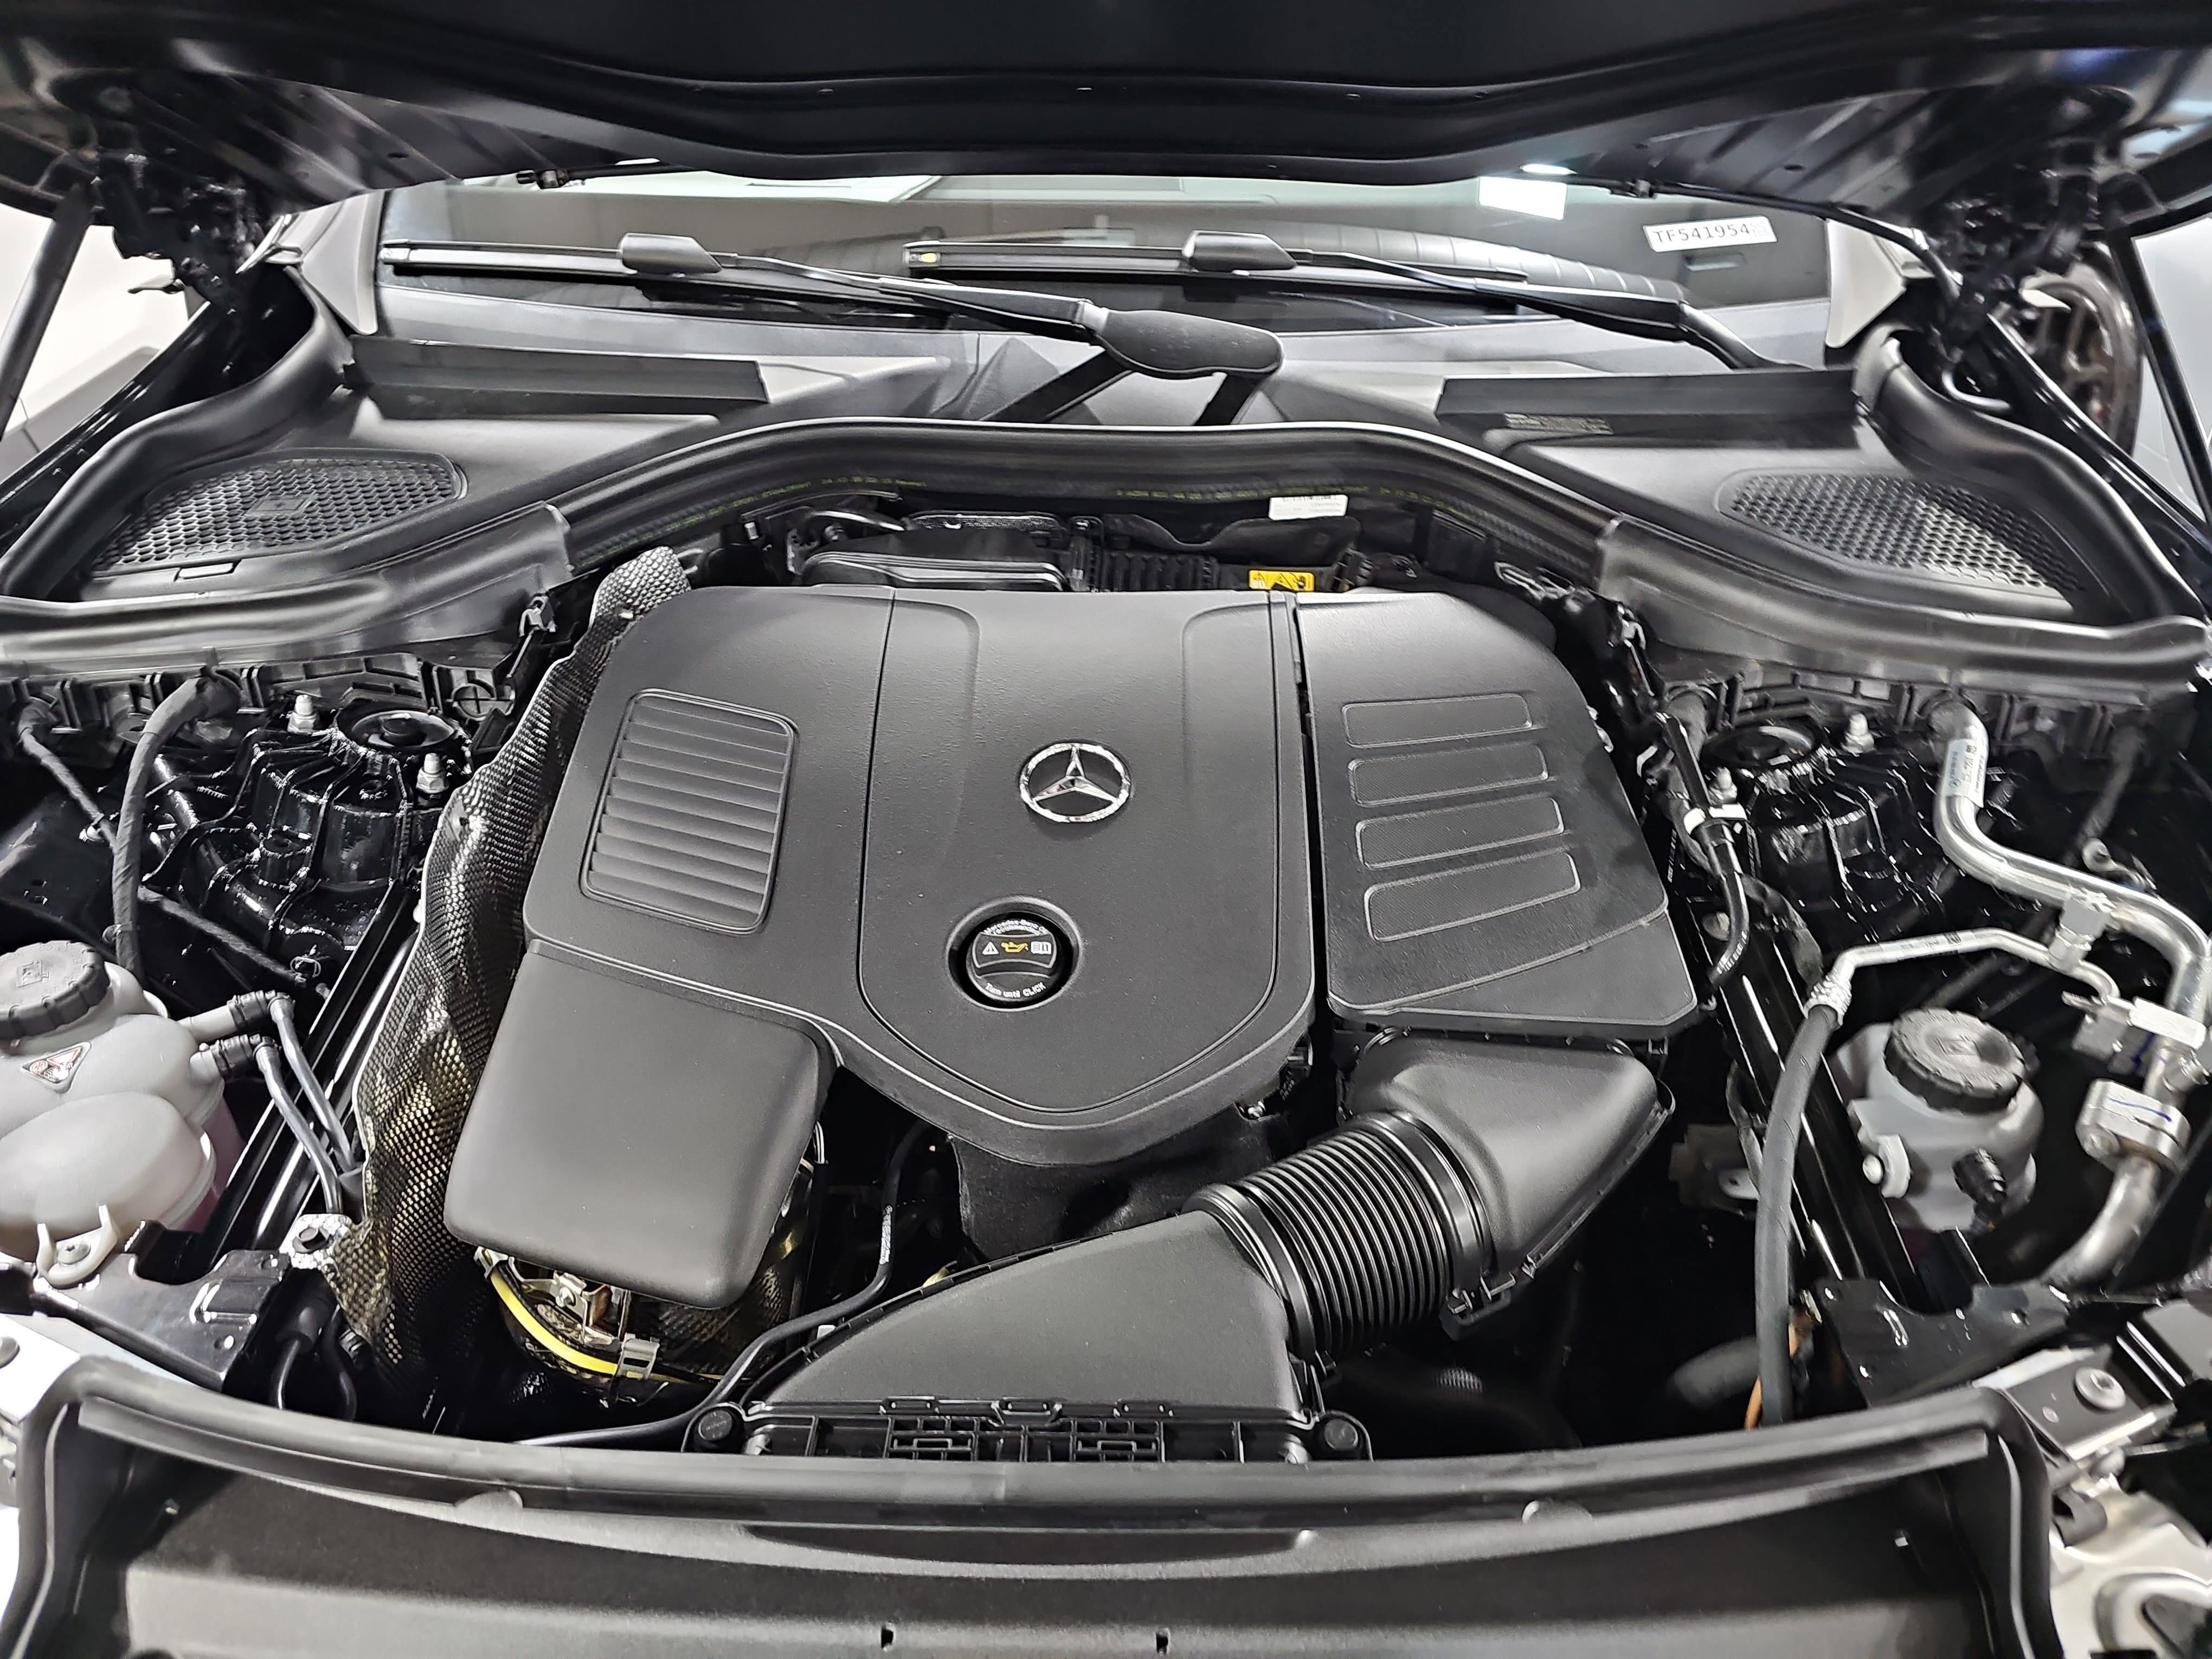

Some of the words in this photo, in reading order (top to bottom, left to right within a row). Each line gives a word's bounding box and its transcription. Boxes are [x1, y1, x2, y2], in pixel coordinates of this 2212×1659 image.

[1654, 223, 1750, 243] TF541954
[985, 982, 1001, 995] Turn
[1023, 982, 1046, 996] CLICK
